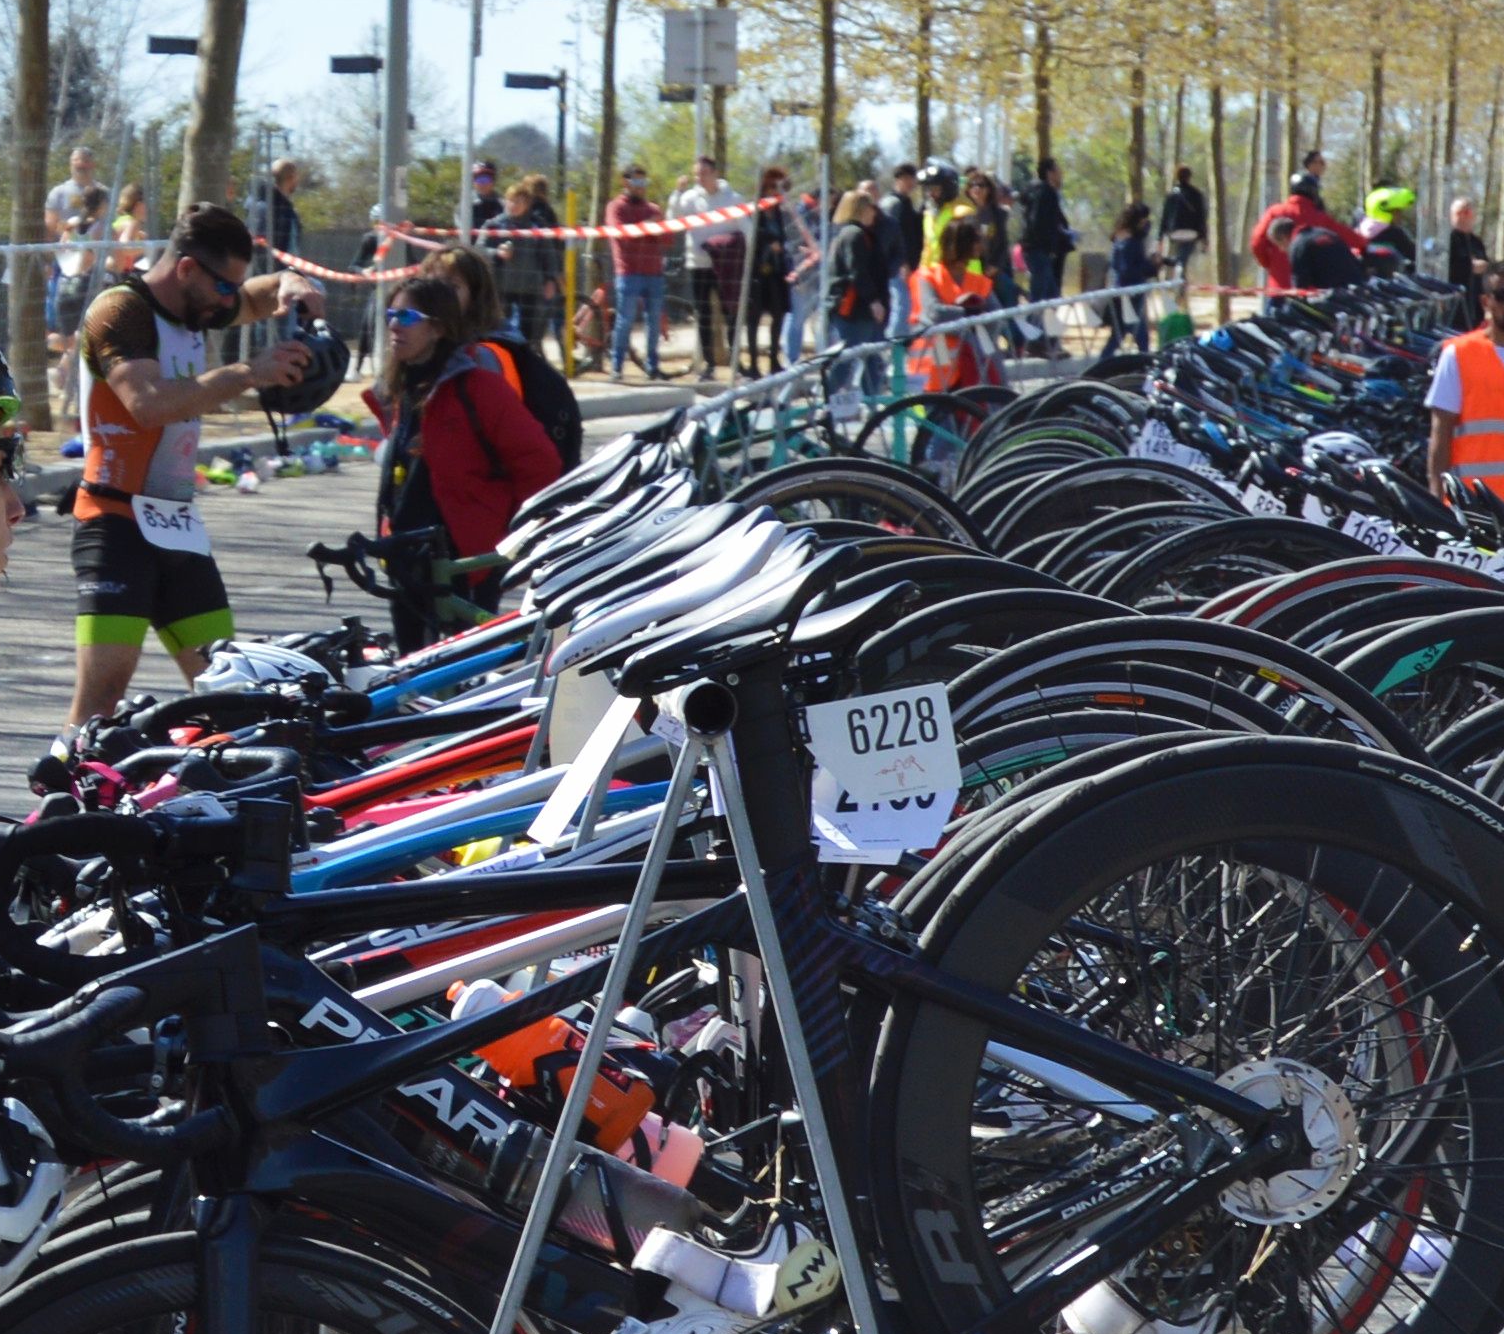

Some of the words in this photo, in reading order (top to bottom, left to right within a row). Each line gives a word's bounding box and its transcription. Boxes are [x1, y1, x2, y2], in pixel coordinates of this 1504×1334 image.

[143, 509, 192, 532] 8347
[1352, 519, 1401, 555] 1687
[845, 696, 938, 755] 6228
